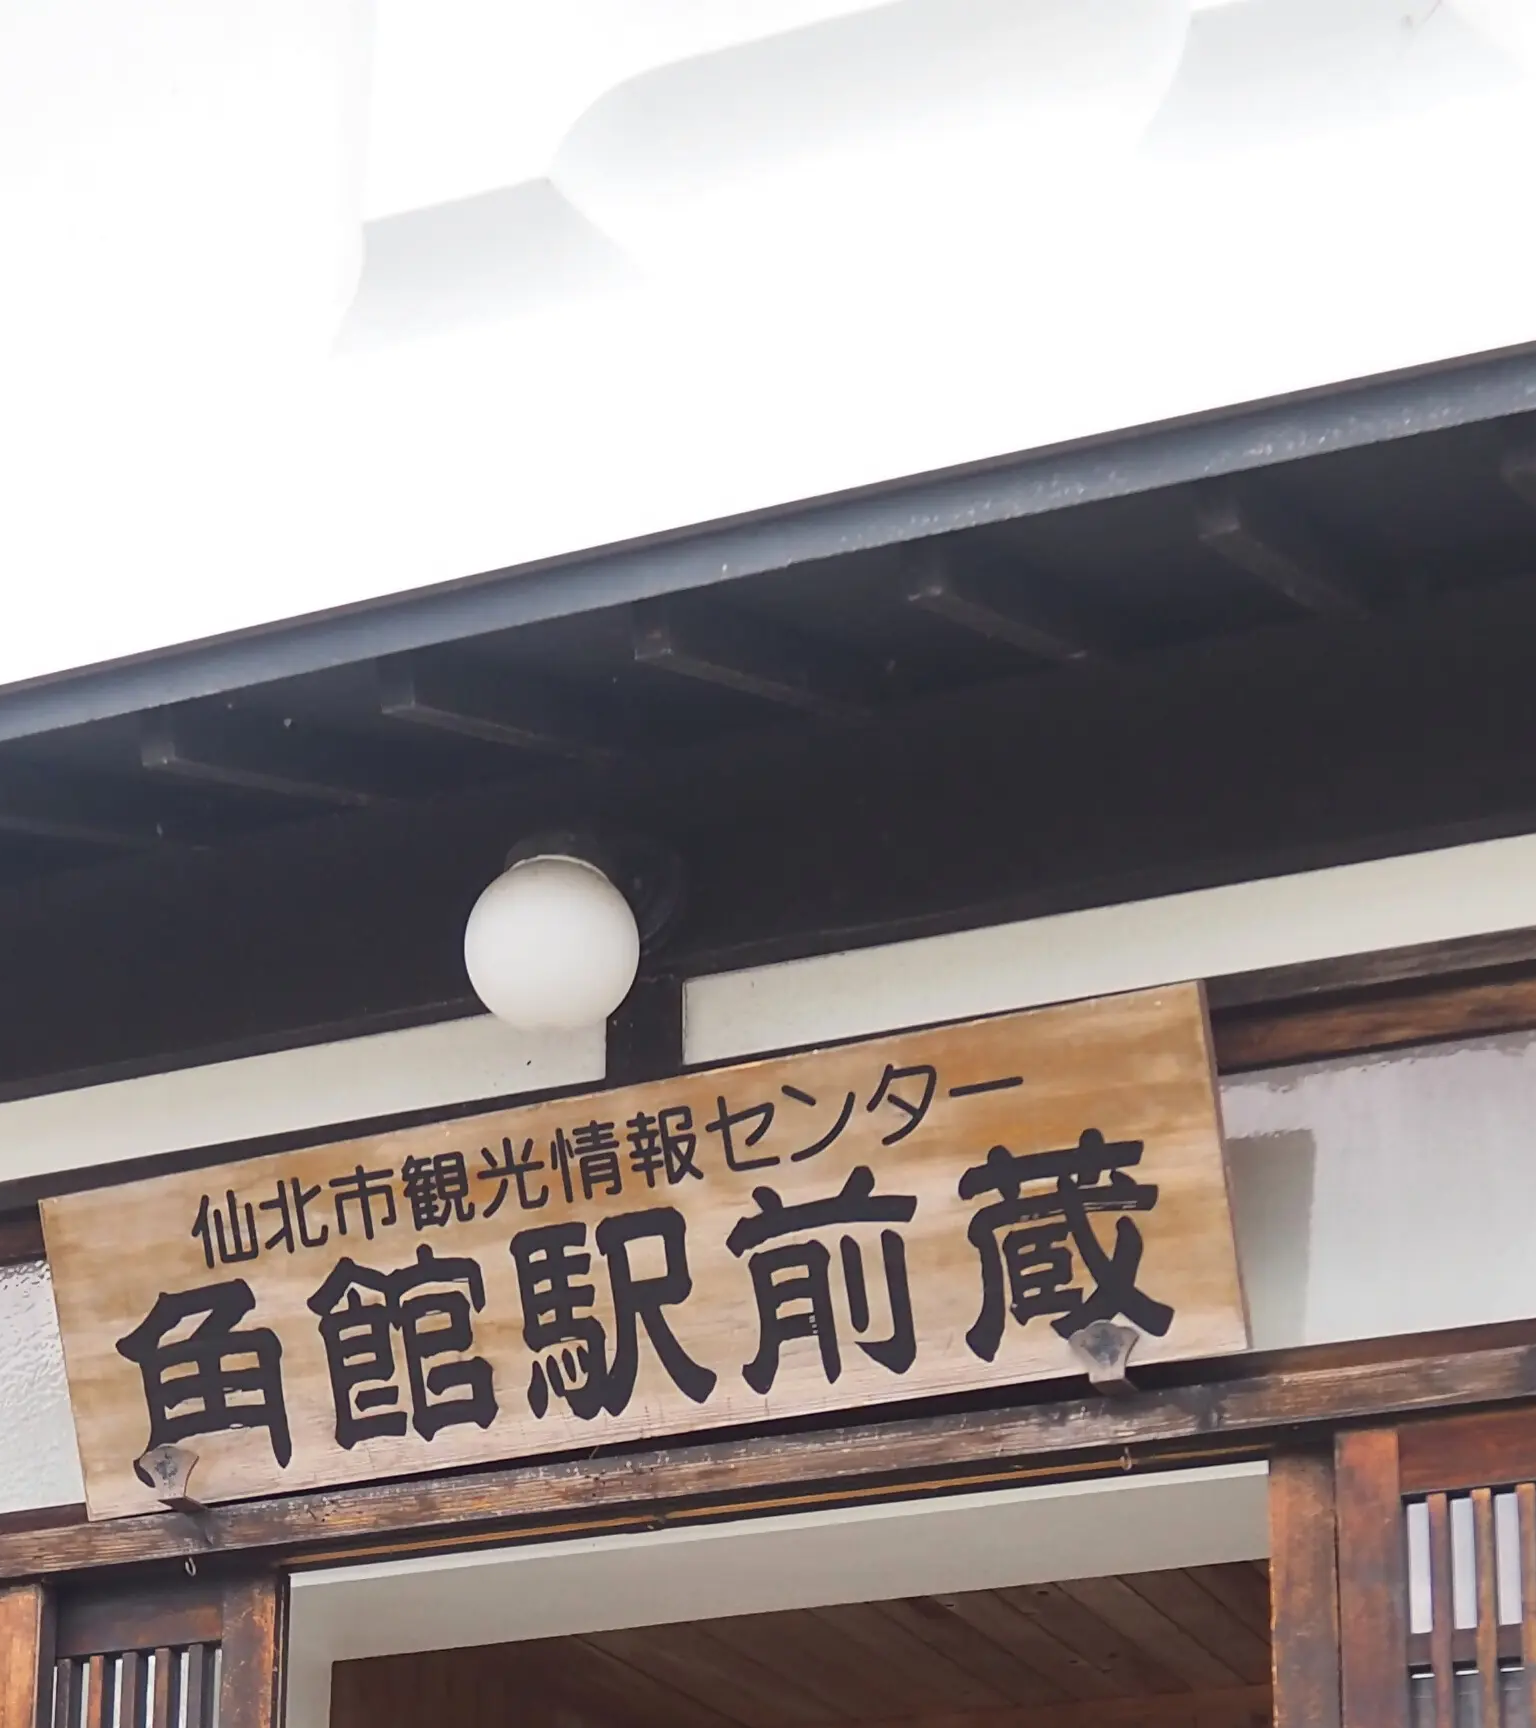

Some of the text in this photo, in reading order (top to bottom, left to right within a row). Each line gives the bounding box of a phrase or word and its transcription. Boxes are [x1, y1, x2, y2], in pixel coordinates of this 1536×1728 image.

[115, 1127, 1175, 1474] 角館駅前蔵
[189, 1061, 1025, 1270] 仙北市観光情報センター
